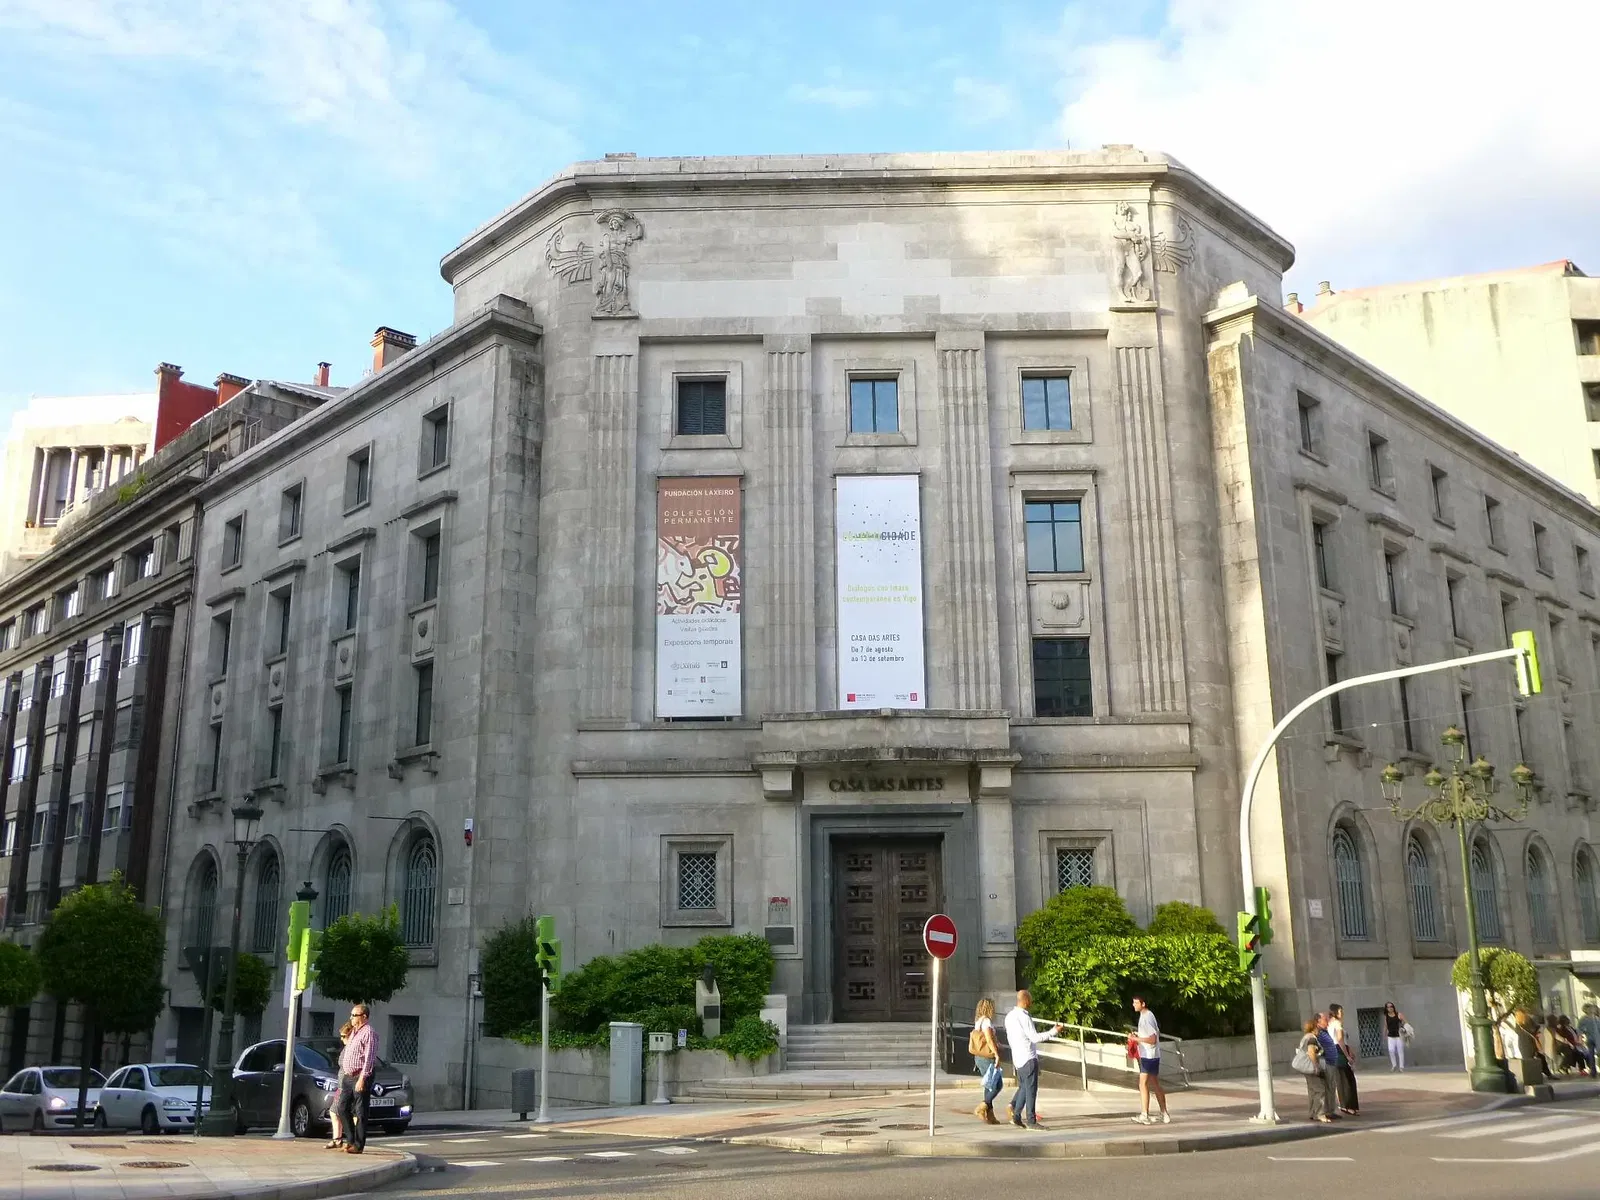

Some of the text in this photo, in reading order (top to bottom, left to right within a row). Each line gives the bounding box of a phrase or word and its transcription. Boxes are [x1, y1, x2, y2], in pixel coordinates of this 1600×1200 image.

[664, 489, 703, 497] FUNDACIÓN
[664, 508, 734, 517] COLECCIÓN
[664, 516, 734, 524] PERMANENTE
[881, 530, 916, 541] CIDADE
[902, 594, 917, 603] Vigo
[703, 637, 734, 646] temporais
[828, 777, 944, 792] CASA DAS ARTES
